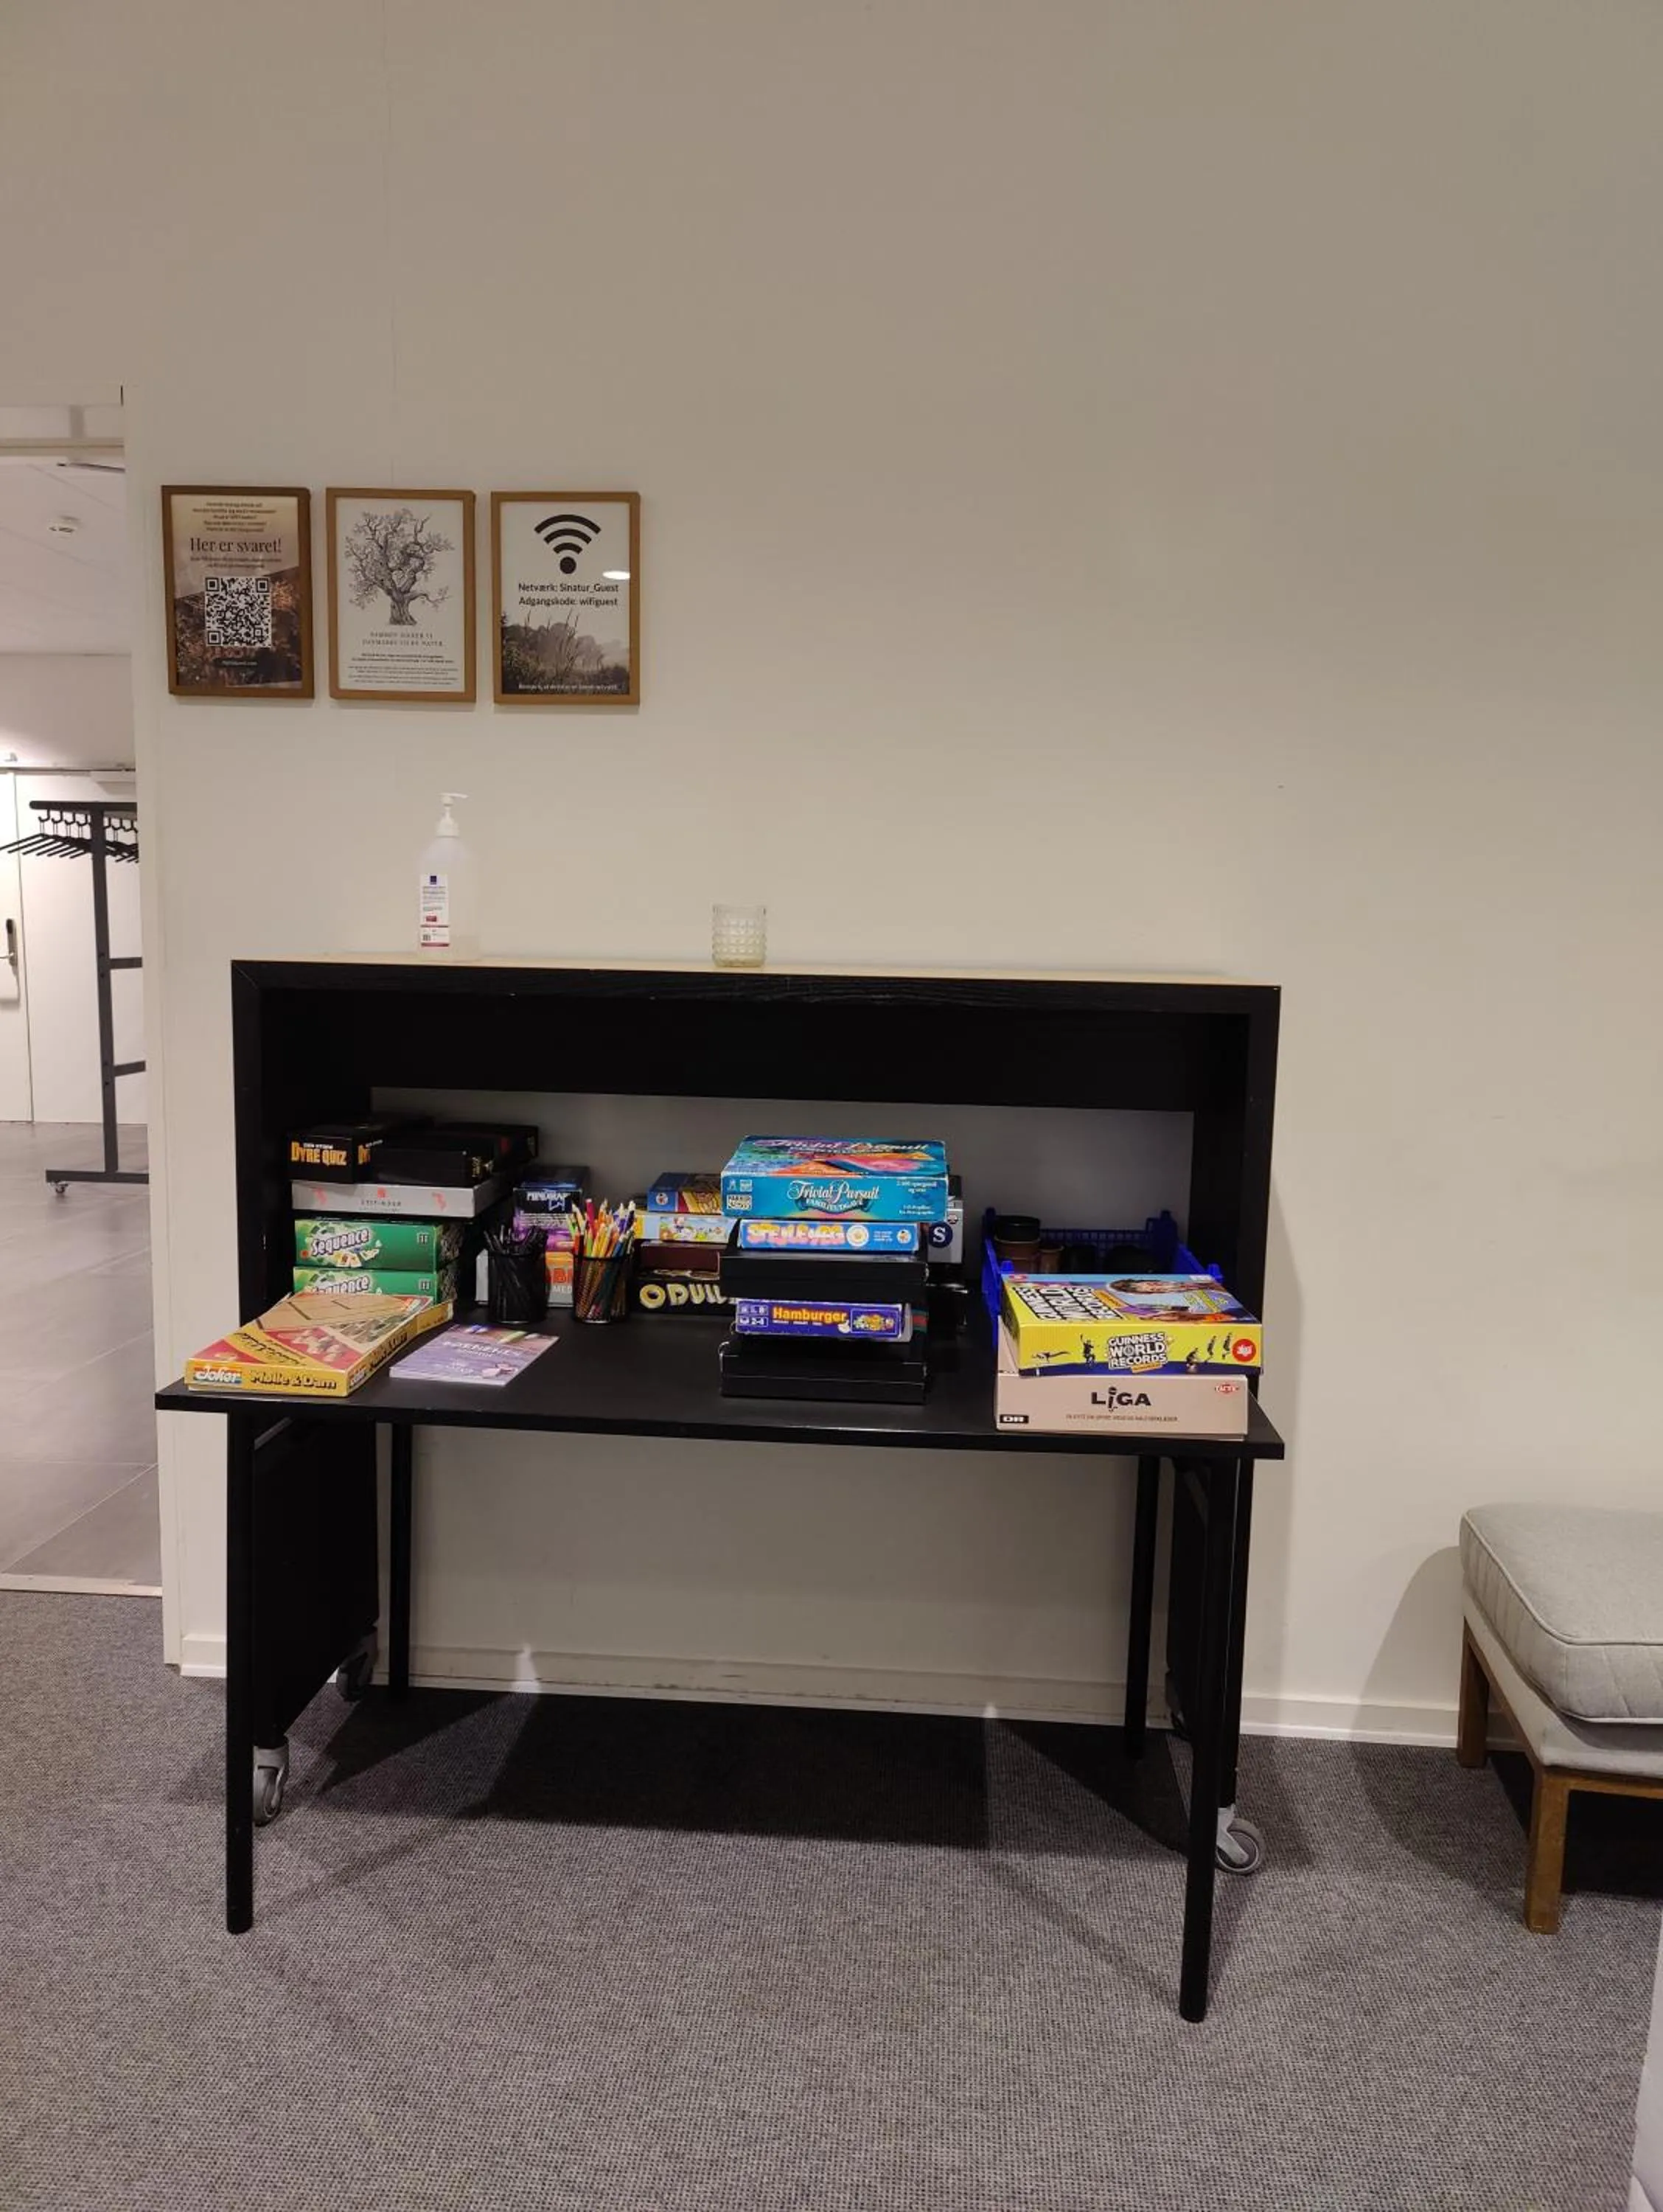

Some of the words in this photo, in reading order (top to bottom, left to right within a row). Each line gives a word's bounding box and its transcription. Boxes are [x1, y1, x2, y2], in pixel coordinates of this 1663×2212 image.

[189, 538, 215, 552] Her
[219, 541, 234, 552] er
[237, 538, 282, 553] svaret!
[559, 582, 618, 594] Sinatur_Guest
[579, 597, 618, 608] wifiguest
[291, 1141, 320, 1163] DYRE
[322, 1150, 346, 1166] QUIZ
[787, 1180, 834, 1200] Trivial
[829, 1180, 879, 1205] Pursuit
[312, 1227, 370, 1257] Sequence
[773, 1306, 848, 1325] Hamburger
[1108, 1332, 1165, 1346] GUINNESS
[1109, 1342, 1165, 1357] WORLD
[1111, 1354, 1167, 1368] RECORDS
[302, 1376, 337, 1390] Dam
